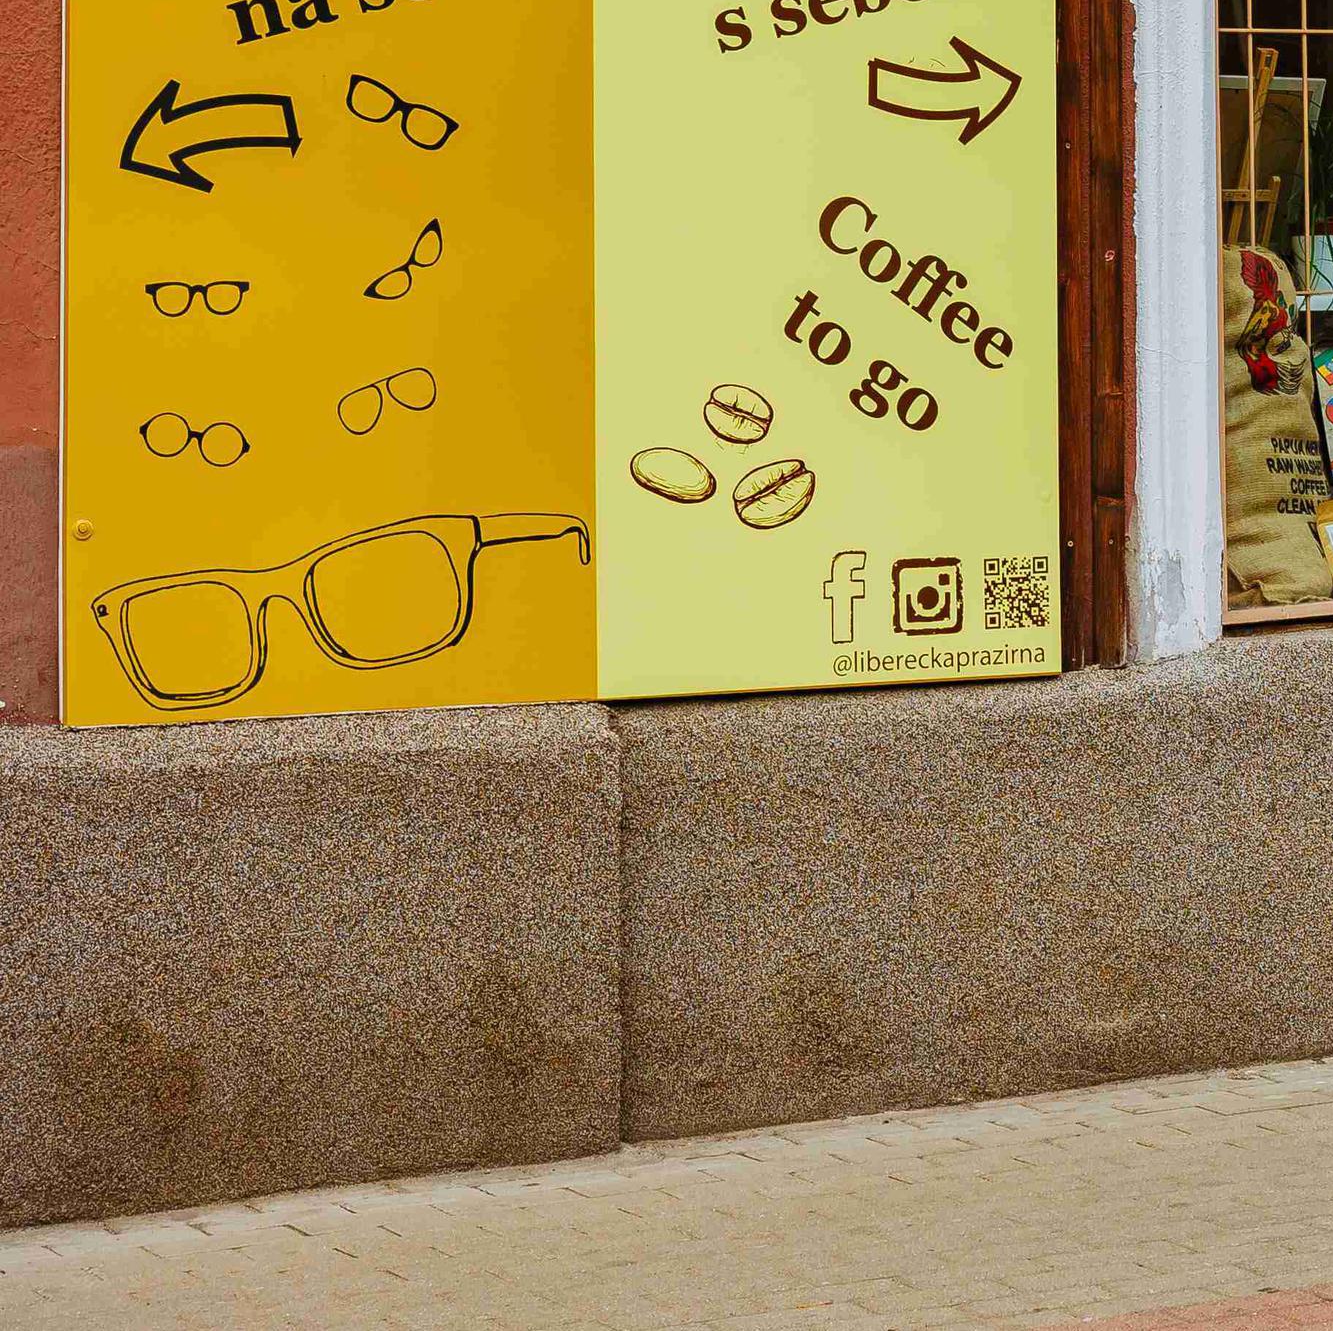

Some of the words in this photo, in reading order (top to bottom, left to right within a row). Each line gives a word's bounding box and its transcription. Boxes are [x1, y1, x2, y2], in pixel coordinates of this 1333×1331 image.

[714, 6, 753, 54] s
[818, 195, 1014, 370] Coffee
[783, 289, 852, 366] to
[848, 359, 939, 432] go
[1270, 437, 1305, 456] PAPUA
[1266, 457, 1294, 474] RAW
[1290, 477, 1327, 496] COFFEE
[1276, 497, 1317, 516] CLEAN
[832, 643, 1046, 677] @libereckaprazirna
